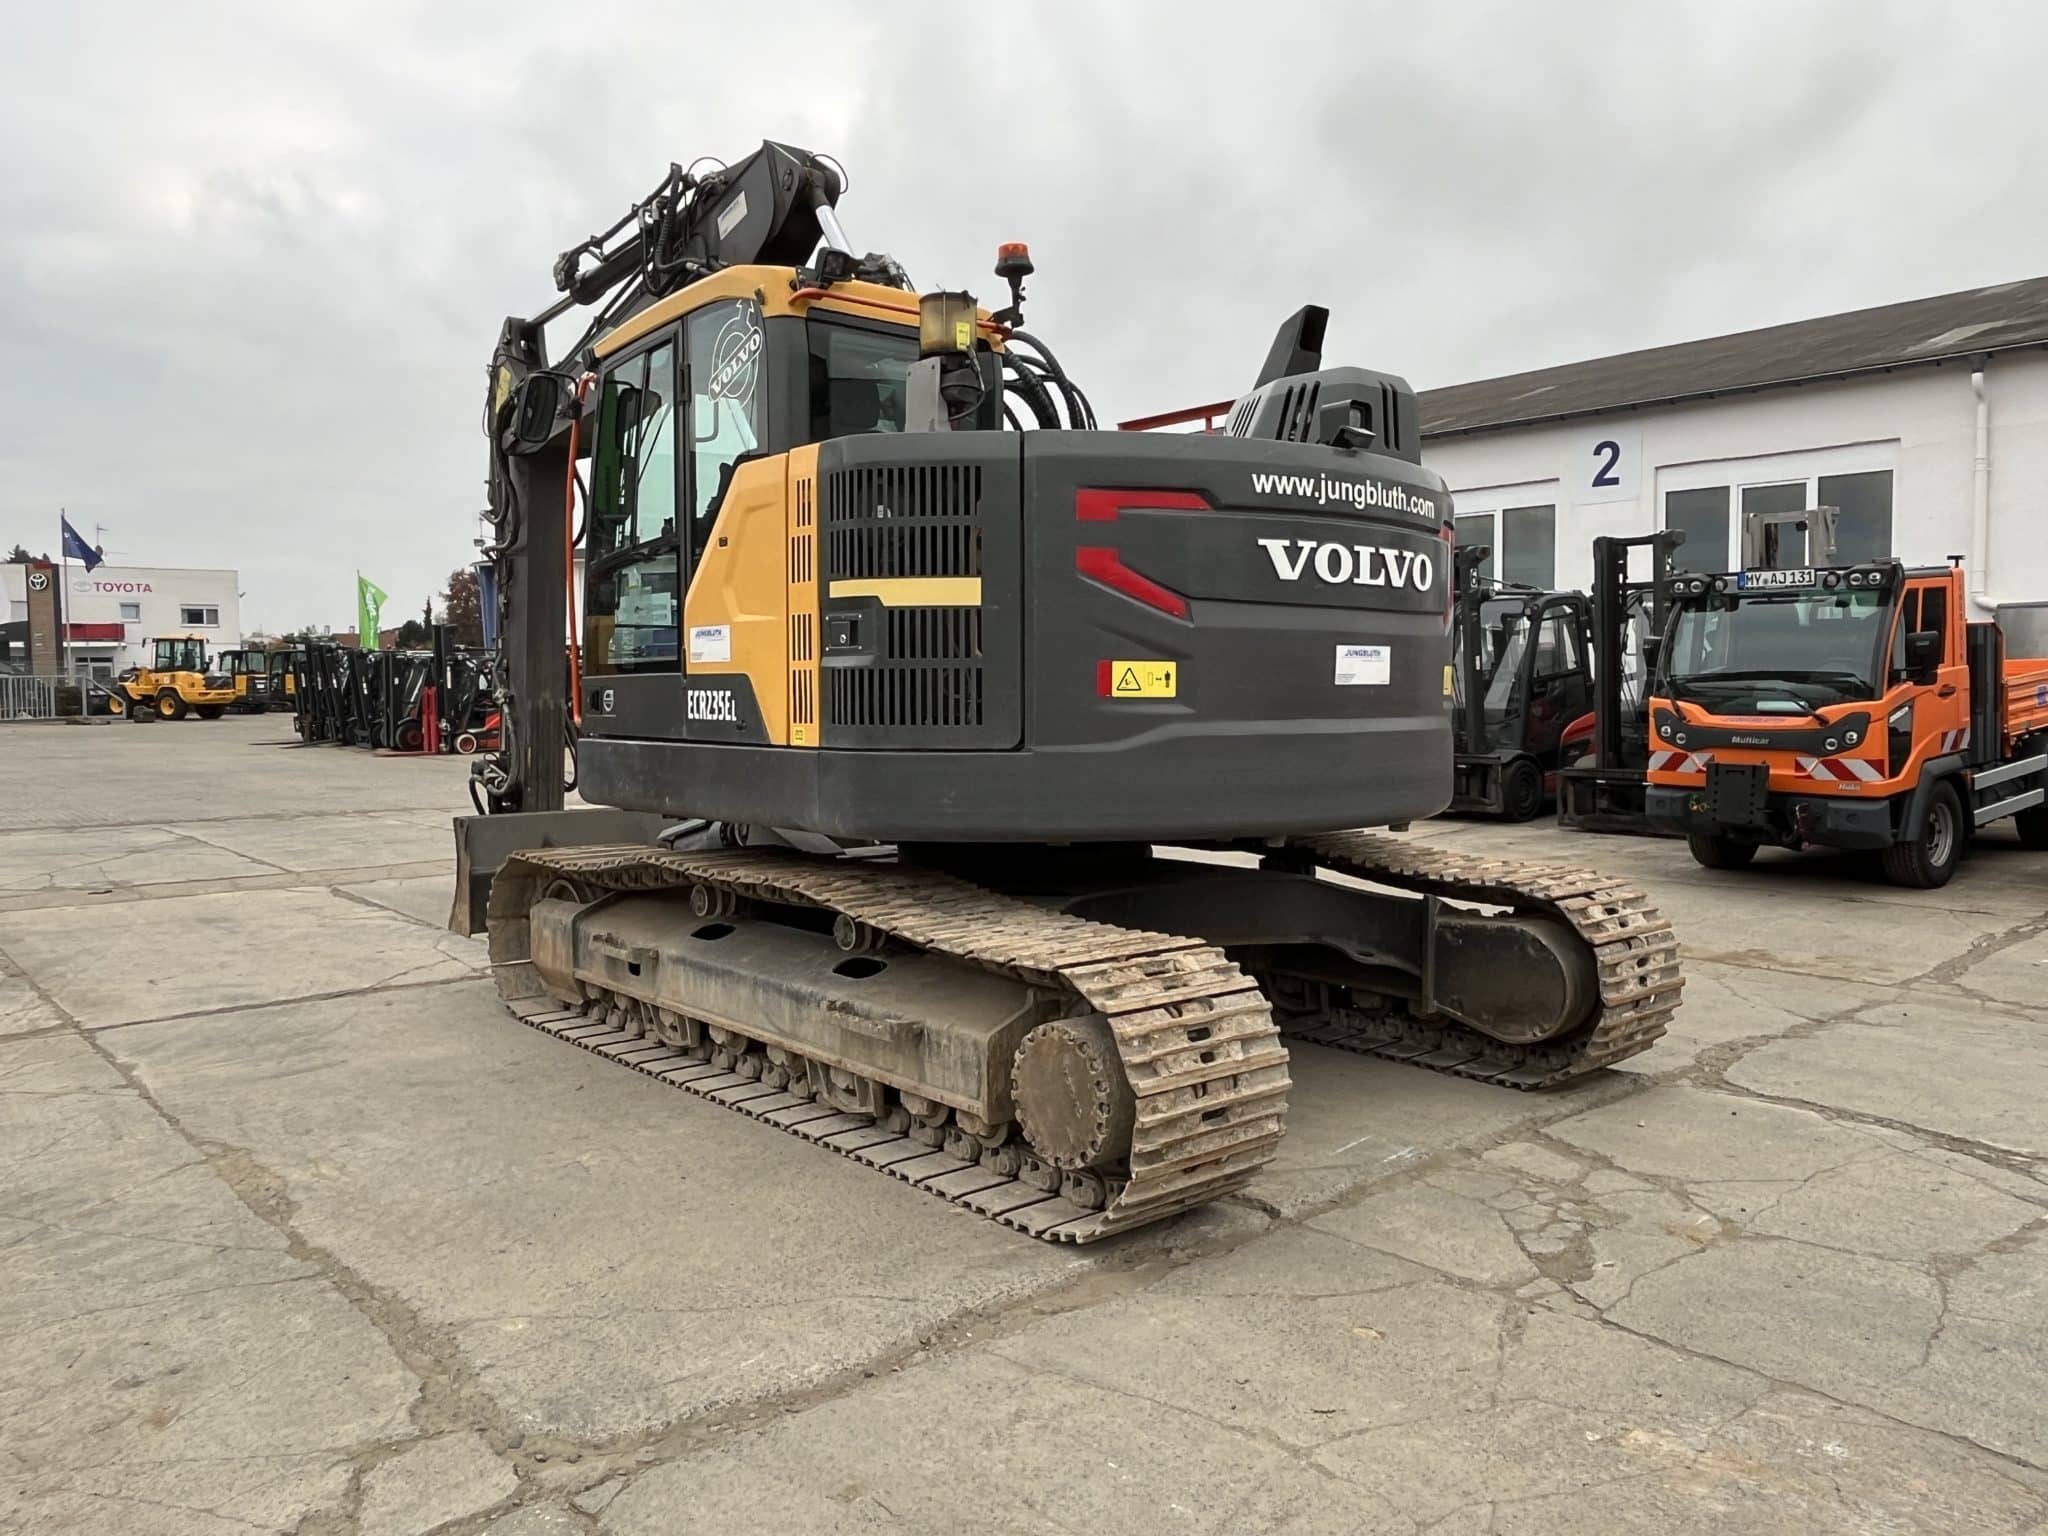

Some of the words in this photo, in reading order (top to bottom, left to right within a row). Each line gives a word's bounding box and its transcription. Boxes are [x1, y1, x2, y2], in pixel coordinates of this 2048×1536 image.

[711, 334, 760, 393] VOLVO
[1592, 441, 1620, 487] 2
[1251, 473, 1435, 519] www.jungbluth.com
[94, 582, 152, 593] TOYOTA
[1257, 538, 1433, 592] VOLVO
[1745, 573, 1761, 586] MY
[1770, 572, 1786, 585] AJ
[1789, 570, 1813, 584] 131
[1731, 735, 1769, 745] Multicar
